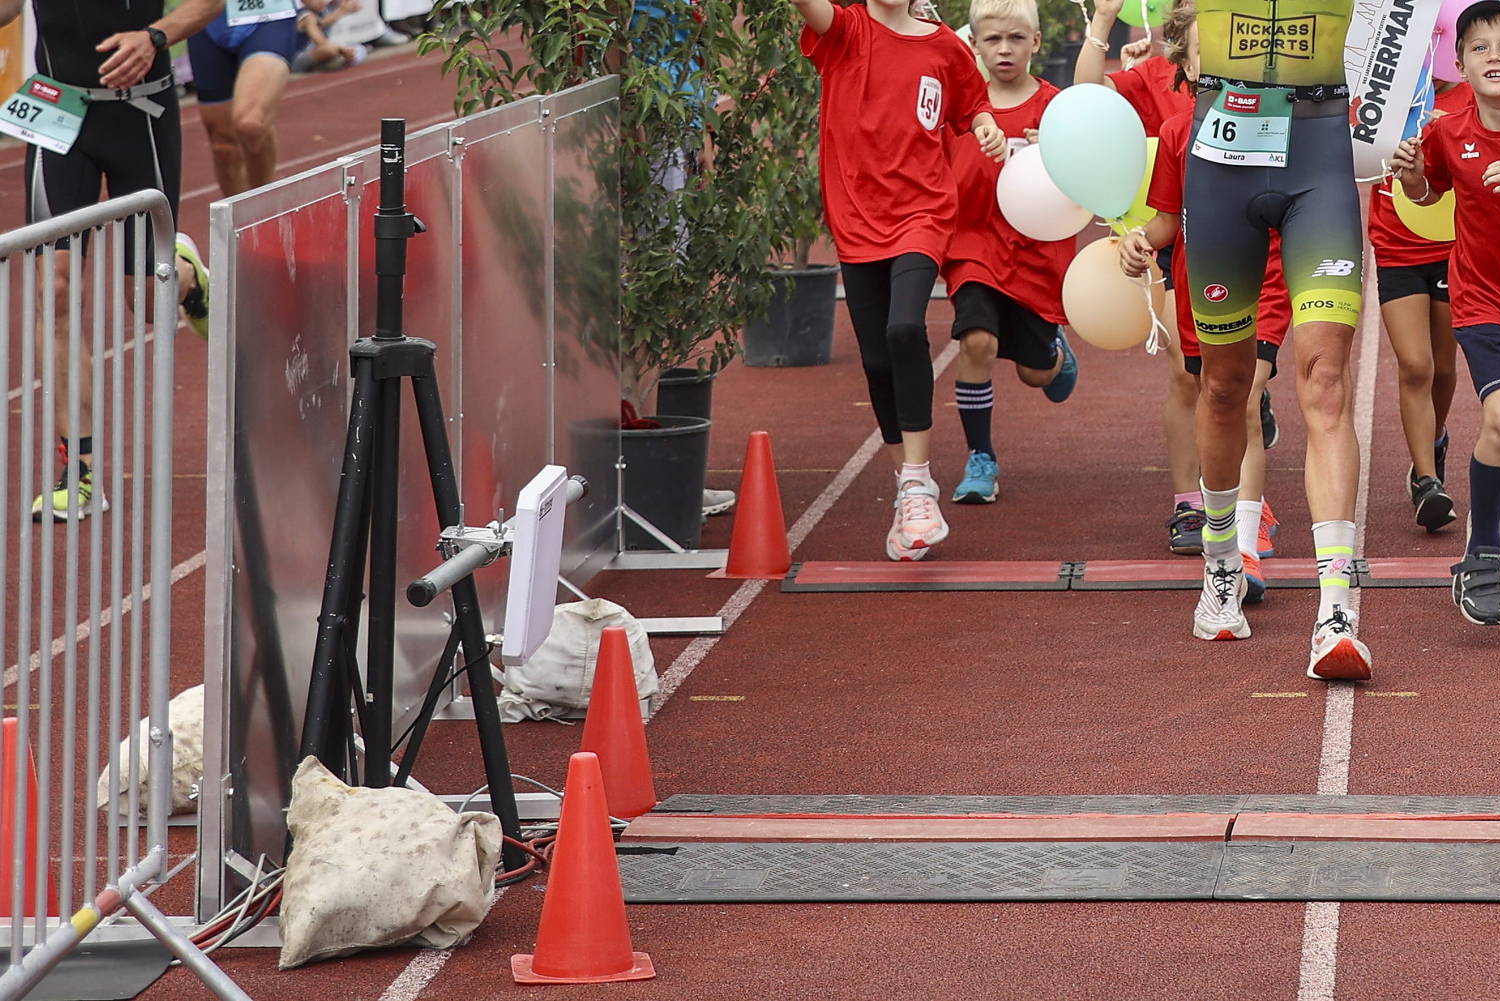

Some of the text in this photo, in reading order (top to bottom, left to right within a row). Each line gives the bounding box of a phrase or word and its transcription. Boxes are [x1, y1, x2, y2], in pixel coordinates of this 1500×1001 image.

[1239, 39, 1309, 51] SPORTS
[1237, 97, 1257, 106] BASF
[7, 99, 43, 123] 487
[1211, 117, 1238, 143] 16
[1223, 151, 1246, 161] Laura
[1299, 300, 1335, 312] ATOS
